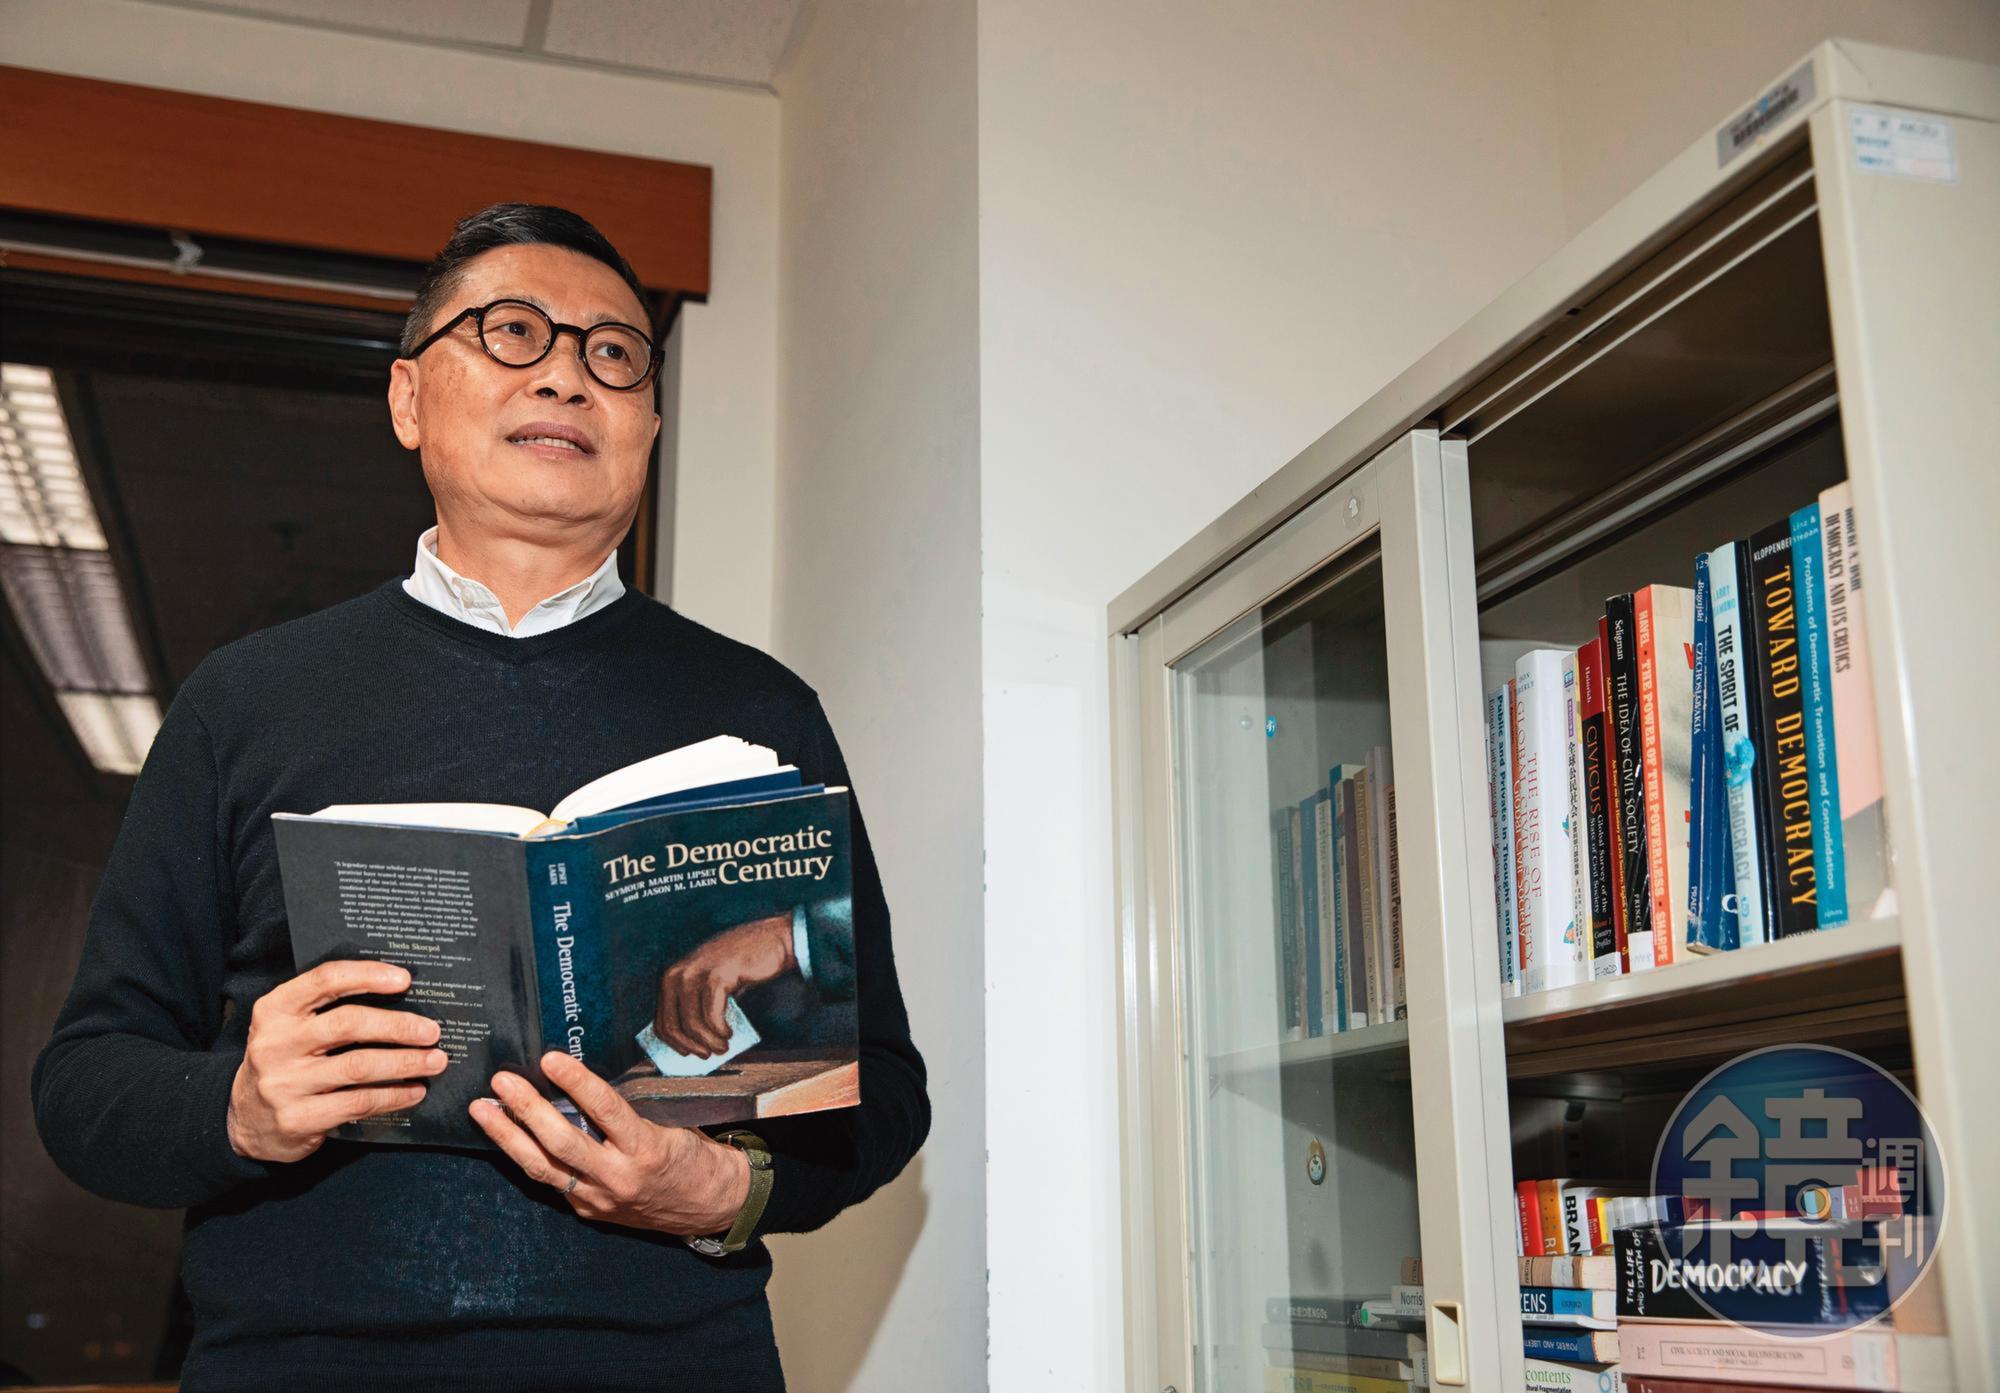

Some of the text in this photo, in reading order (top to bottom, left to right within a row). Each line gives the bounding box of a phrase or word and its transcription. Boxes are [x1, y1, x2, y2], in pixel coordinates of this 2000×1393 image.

[1810, 516, 1816, 524] &
[1825, 513, 1850, 673] DEMOCRACY AND ITS CRITICS
[1614, 618, 1624, 660] Seligman
[1639, 610, 1649, 647] HAVEL
[1764, 565, 1799, 698] TOWARD
[1694, 642, 1704, 734] CZECHOSLOVAKIA
[1718, 624, 1739, 732] THE SPIRIT OF
[1804, 556, 1834, 890] Problems of Democratic Transition and Consolidation
[1586, 726, 1600, 814] CIVICUS
[1616, 672, 1638, 854] THE IDEA OF CIVIL SOCIETY
[1642, 658, 1664, 896] THE POWER OF THE POWERLESS
[1528, 752, 1542, 898] THE RISE OF
[1776, 712, 1817, 904] DEMOCRACY
[1502, 826, 1507, 840] in
[1730, 784, 1750, 881] DEMOCRACY
[602, 824, 832, 883] The Democratic
[718, 854, 833, 885] Century
[1388, 812, 1400, 896] Authoritarian
[549, 864, 558, 885] LAKIN
[558, 863, 567, 885] LIPSET
[604, 867, 716, 901] SEYMOUR MARTIN LIPSET
[623, 876, 718, 903] and JASON M. LAKIN
[1600, 884, 1606, 895] of
[1592, 880, 1600, 912] Society
[553, 901, 572, 932] The
[1391, 896, 1402, 969] Personality
[388, 941, 410, 949] Theda
[1656, 911, 1668, 963] SHARPE
[557, 936, 581, 1021] Democratic
[1336, 957, 1345, 984] Day
[1632, 1232, 1641, 1246] OF
[1625, 1248, 1635, 1304] THE LIFE
[1635, 1249, 1645, 1289] DEATH
[1650, 1258, 1808, 1297] DEMOCRACY
[1400, 1291, 1423, 1306] Norris
[1520, 1293, 1547, 1313] ENS
[1542, 1340, 1554, 1349] AND
[1556, 1342, 1578, 1351] POWERS
